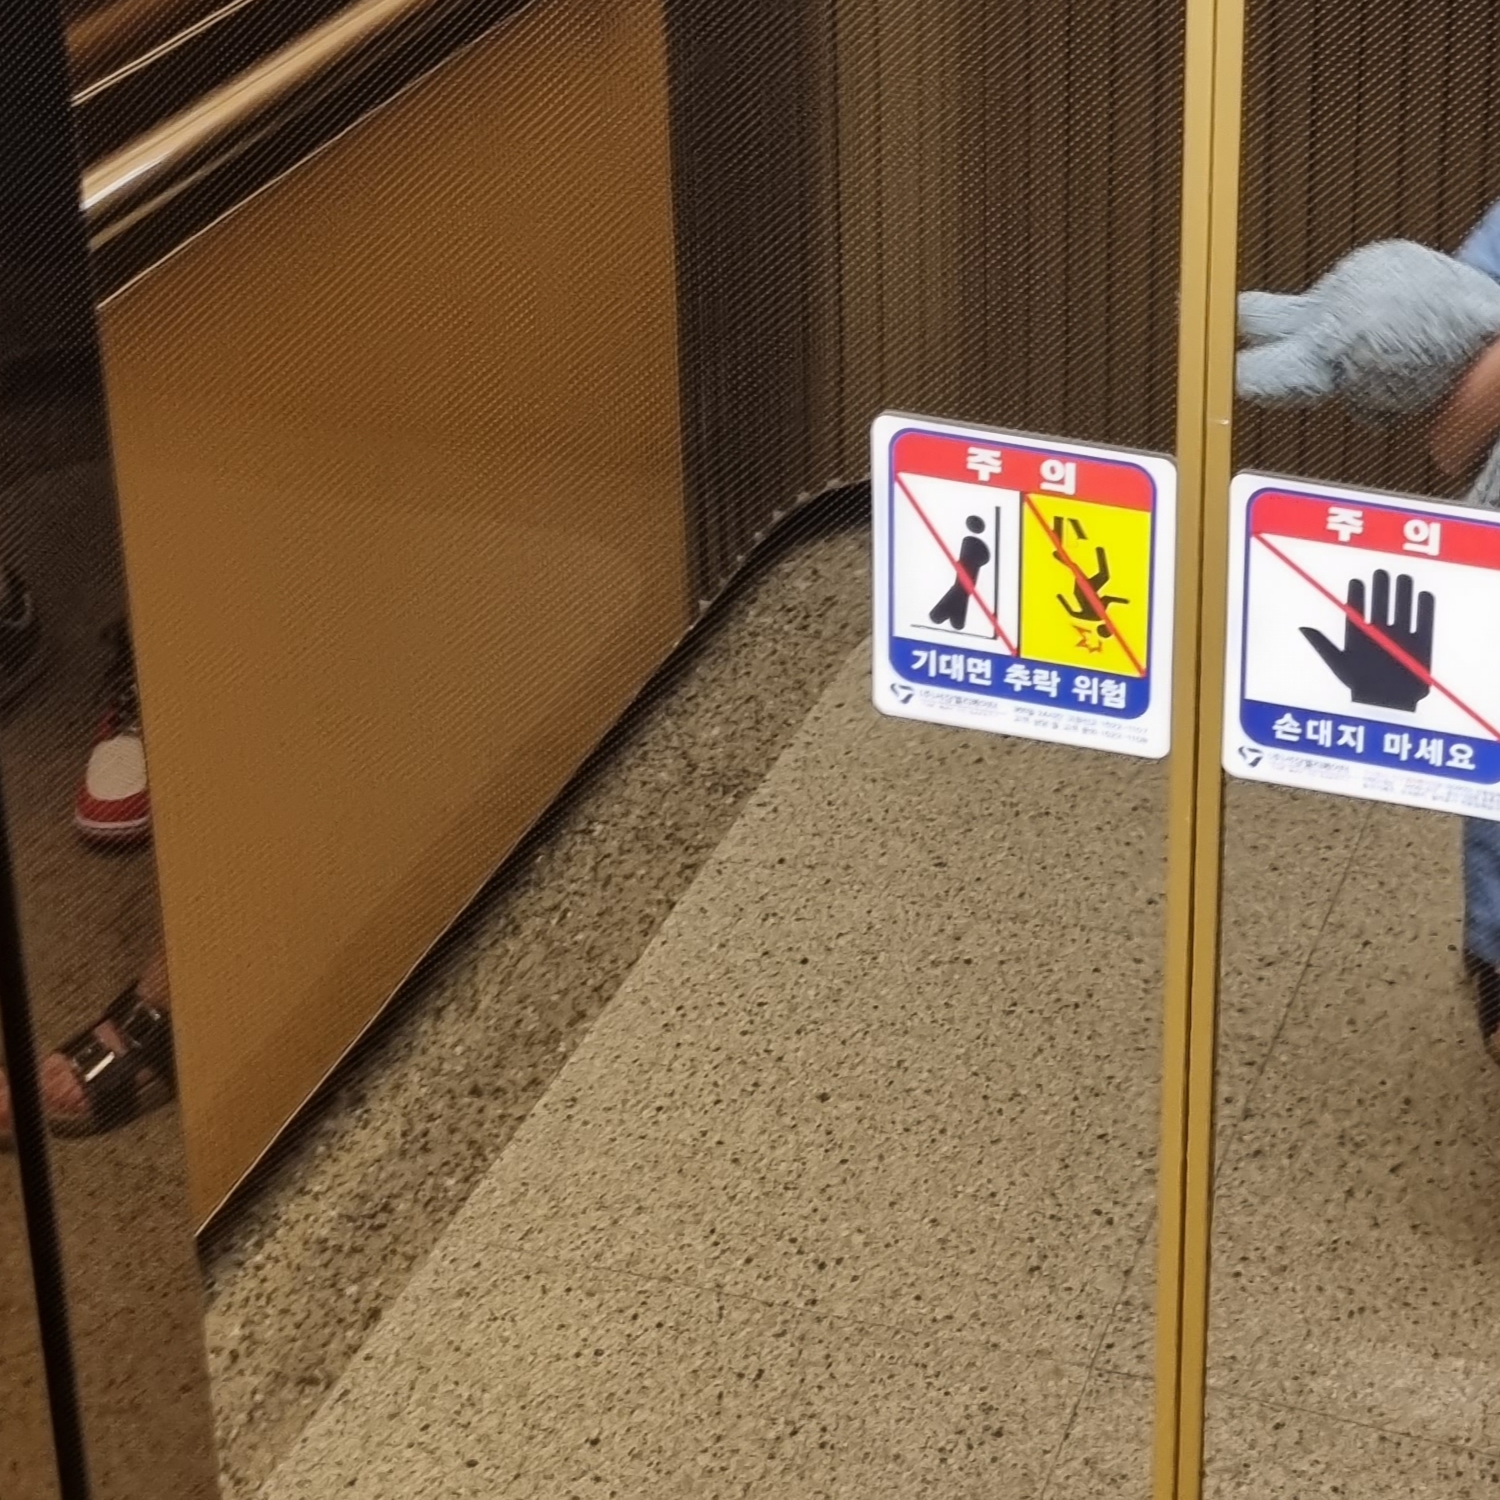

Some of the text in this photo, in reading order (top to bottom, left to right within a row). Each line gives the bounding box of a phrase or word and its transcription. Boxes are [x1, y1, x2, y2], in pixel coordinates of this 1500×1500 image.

[911, 649, 1127, 709] 기대면 추락 위험
[1272, 712, 1365, 754] 손대지
[1382, 731, 1477, 771] 마세요
